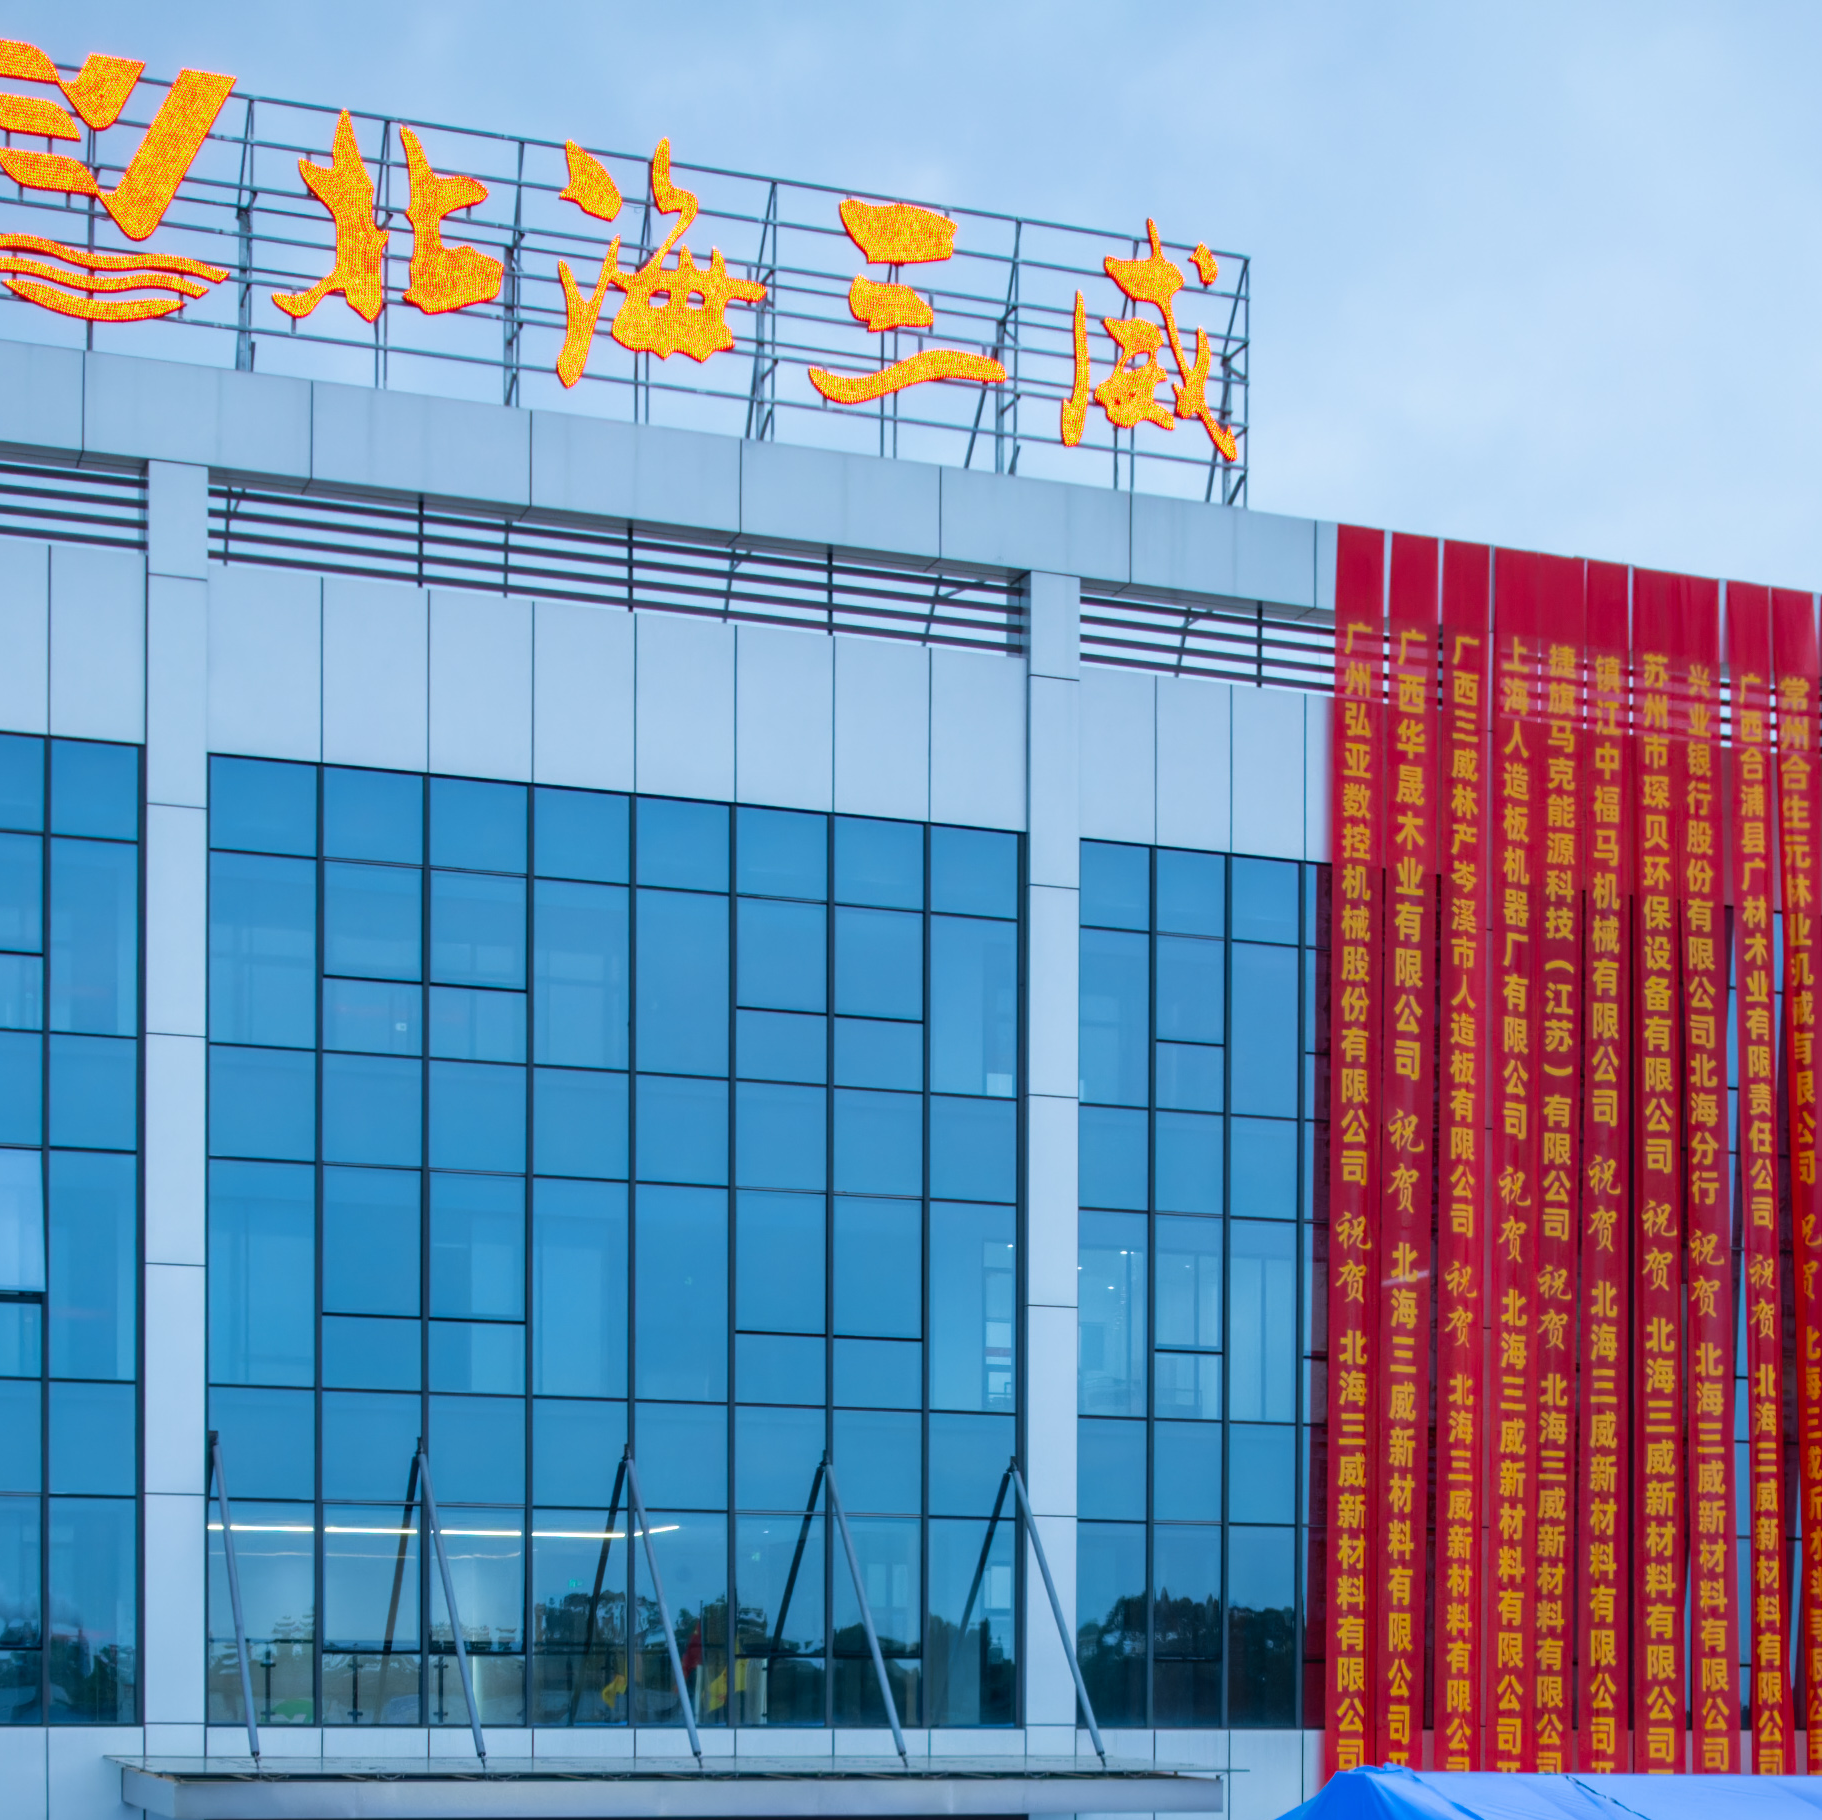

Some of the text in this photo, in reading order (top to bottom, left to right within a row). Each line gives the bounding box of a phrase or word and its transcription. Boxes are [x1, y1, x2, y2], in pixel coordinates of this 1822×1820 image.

[270, 108, 1238, 464] 北海三威
[1393, 629, 1428, 1081] 广西华晟木业有限公司
[1448, 635, 1480, 1238] 广西三威林产岑溪市人造板有限公司
[1501, 637, 1531, 1140] 上海人造板机器厂有限公司
[1590, 655, 1622, 1127] 镇江中福马机械有限公司
[1738, 673, 1775, 1229] 广西合浦县广林木业有限责任公司
[1334, 622, 1374, 1770] 广州弘亚数控机械股份有限公司 祝贺 北海三威新材料有限公司
[1386, 1109, 1426, 1213] 祝贺
[1443, 1260, 1479, 1345] 祝贺
[1497, 1166, 1533, 1263] 祝贺
[1536, 1264, 1573, 1349] 祝贺
[1586, 1155, 1622, 1251] 祝贺
[1640, 653, 1679, 1775] 苏州市琛贝环保设备有限公司 祝贺 北海三威新材料有限公司
[1685, 665, 1731, 1771] 兴业银行股份有限公司北海分行 祝贺 北海三威新材料有限公司
[1747, 1254, 1776, 1338] 祝贺
